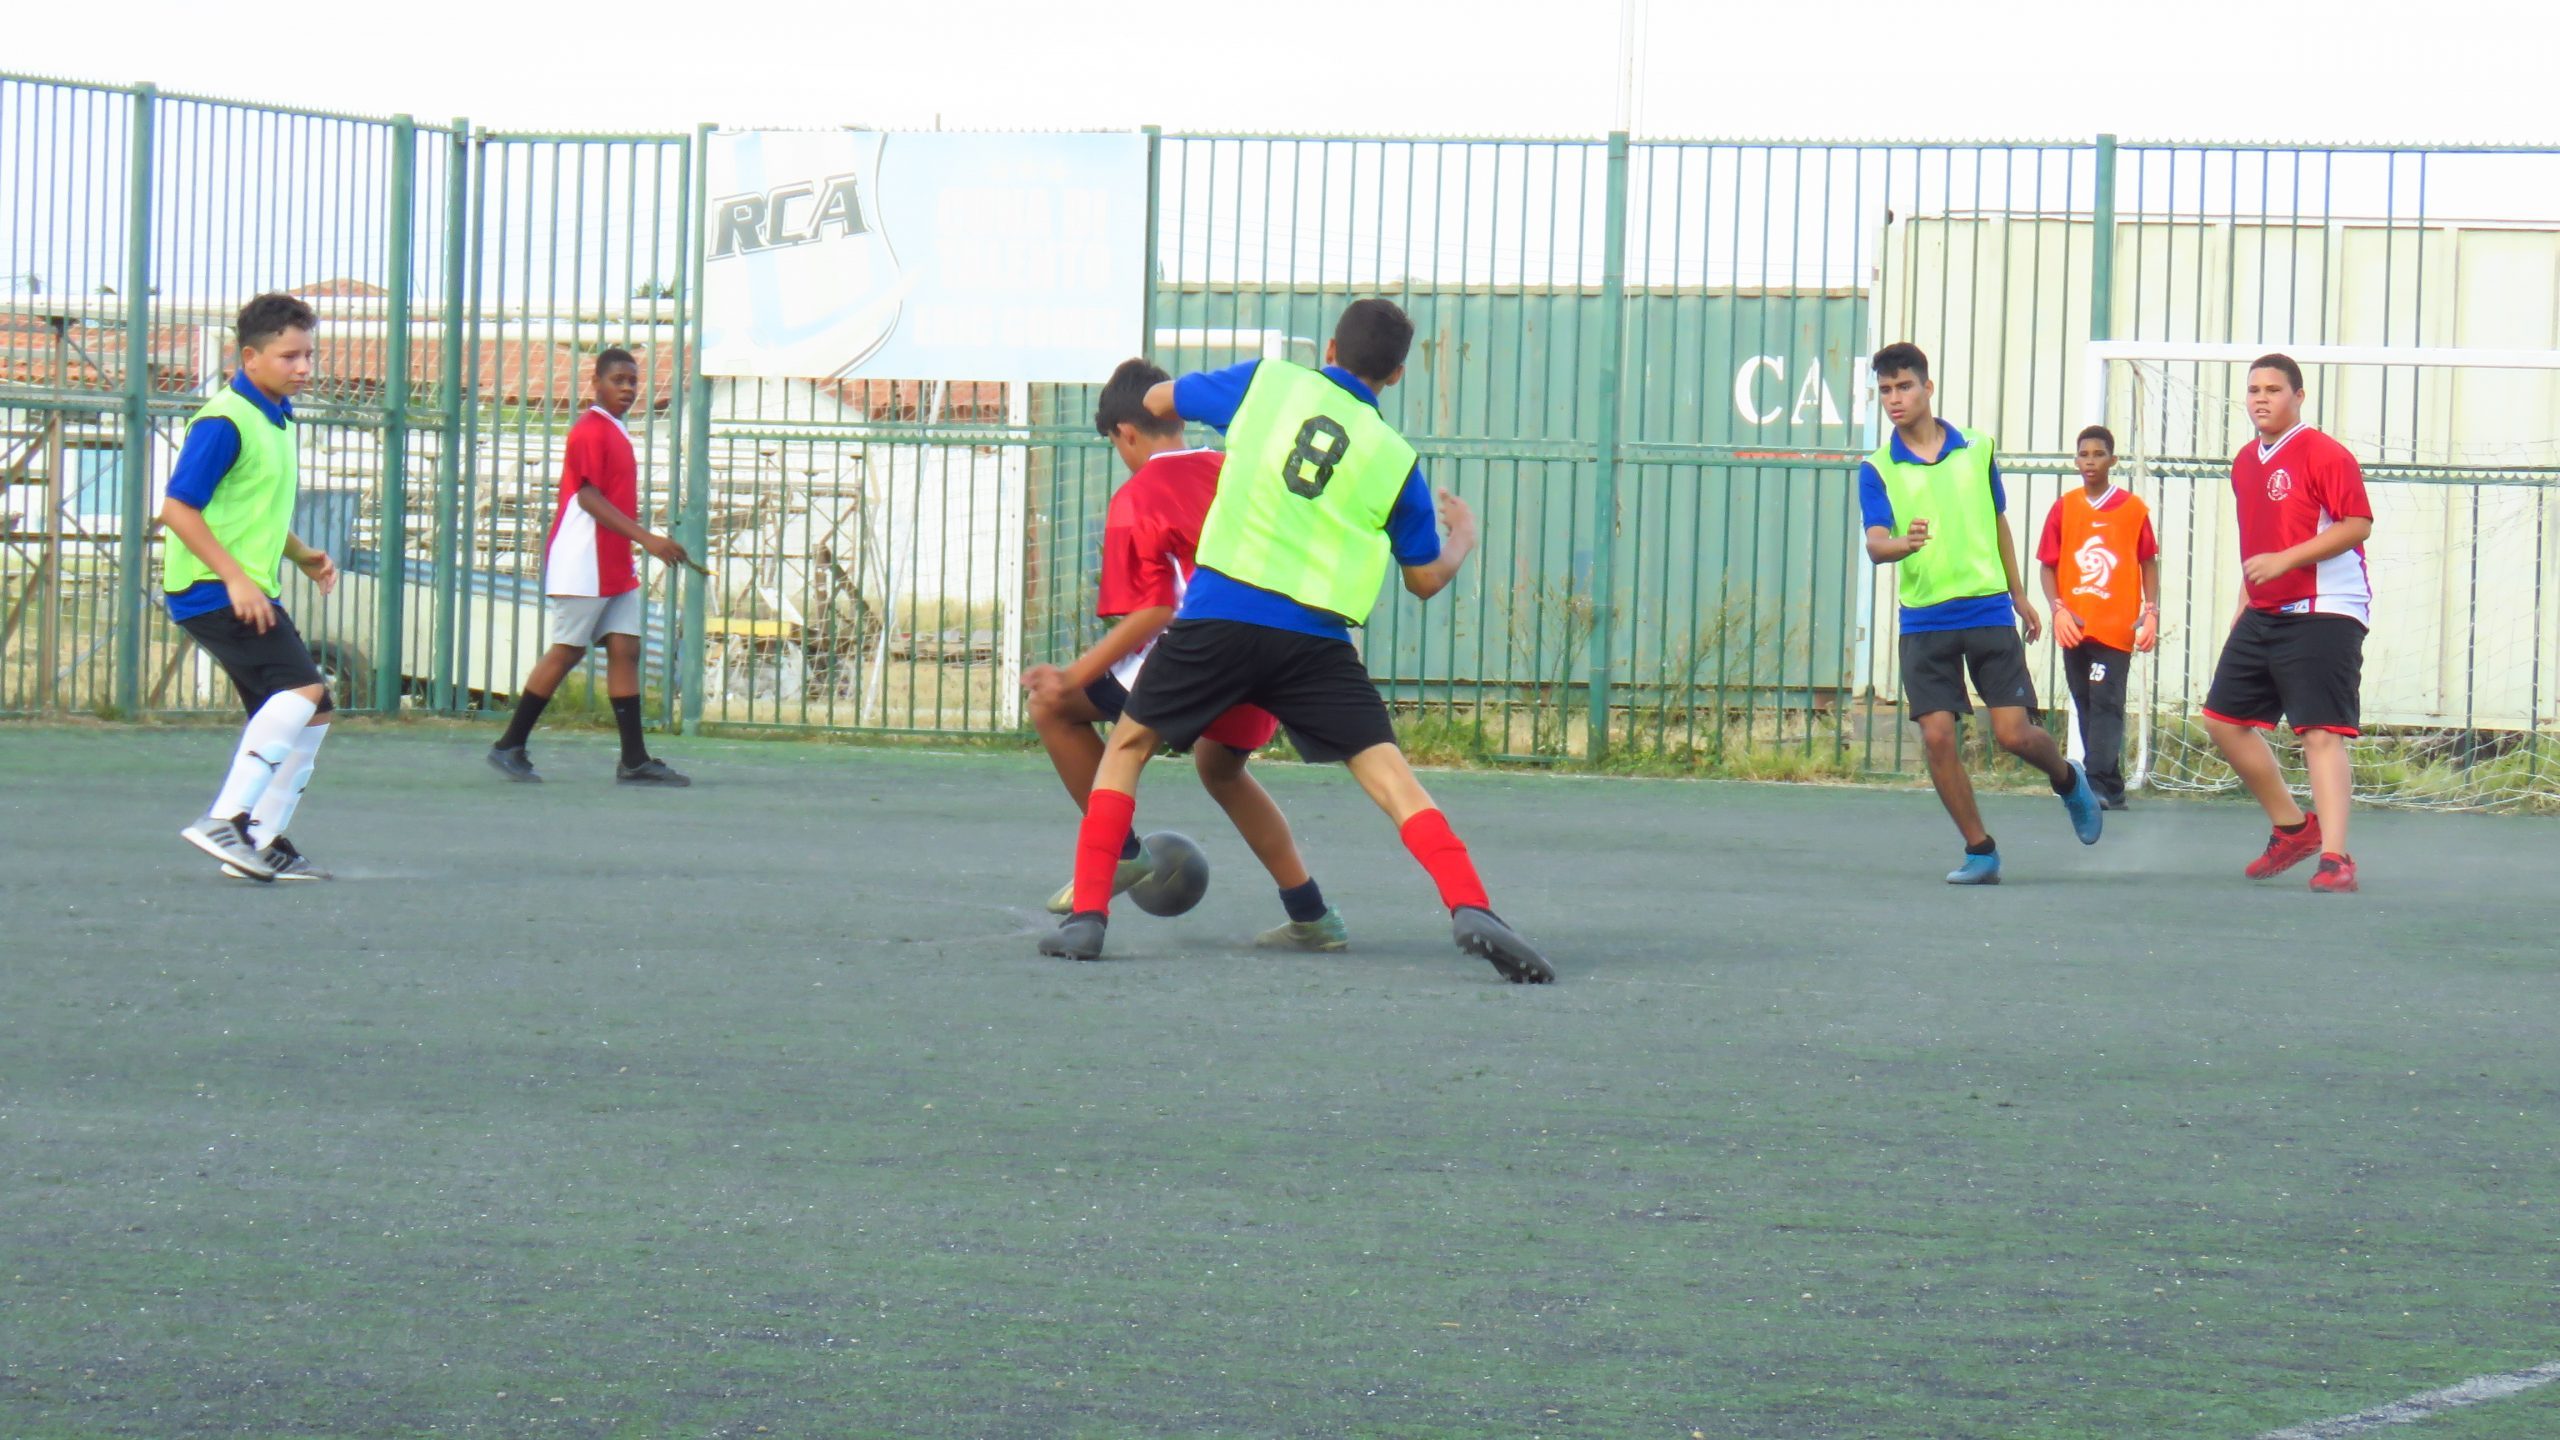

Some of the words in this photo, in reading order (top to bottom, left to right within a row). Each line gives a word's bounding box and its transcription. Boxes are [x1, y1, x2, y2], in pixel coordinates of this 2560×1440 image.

[706, 172, 874, 261] RCA
[1282, 414, 1350, 499] 8
[2089, 662, 2106, 682] 25
